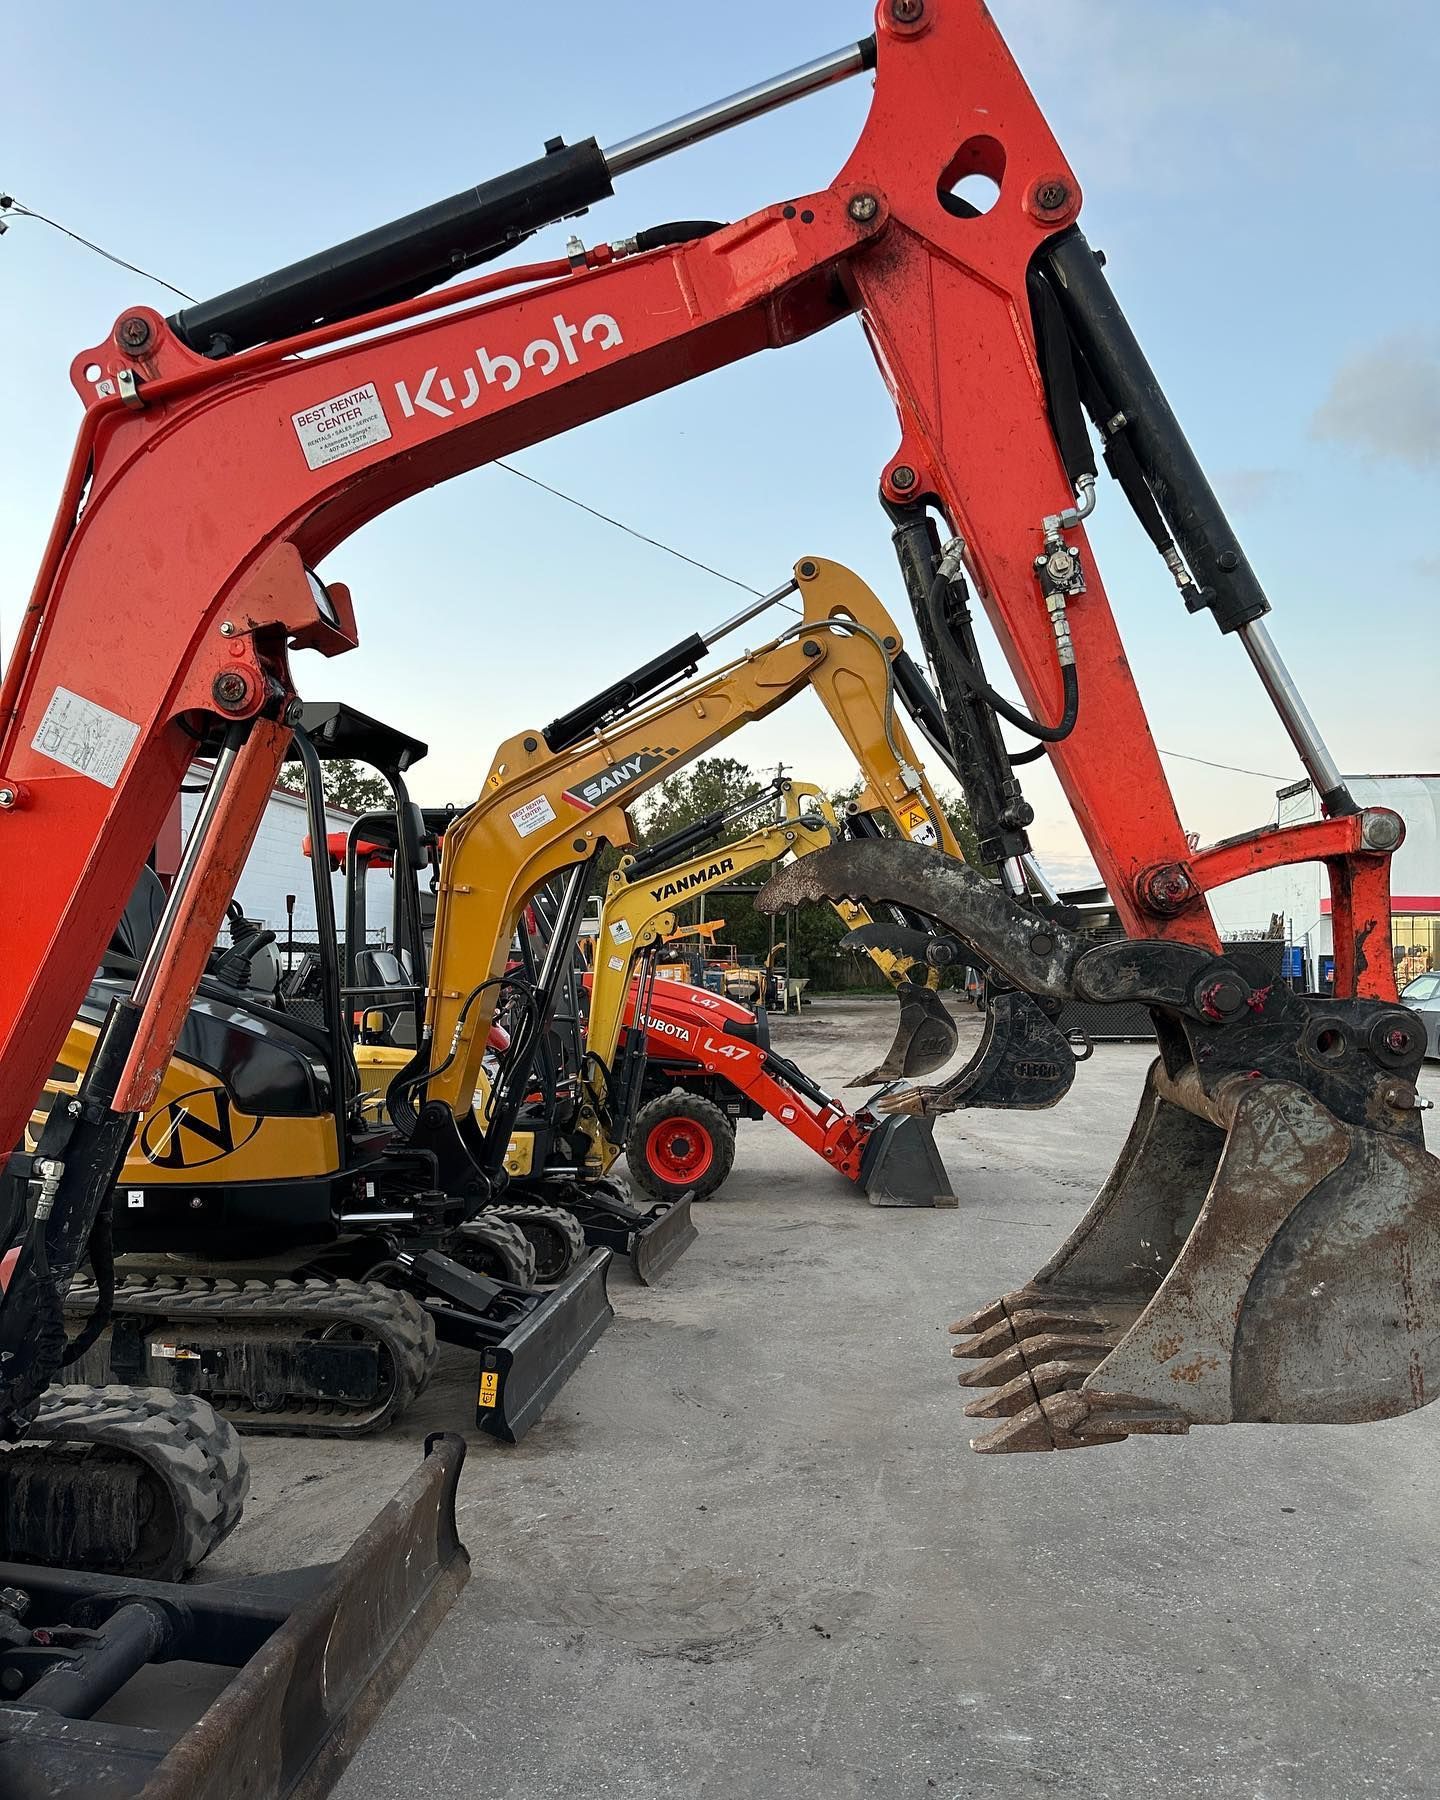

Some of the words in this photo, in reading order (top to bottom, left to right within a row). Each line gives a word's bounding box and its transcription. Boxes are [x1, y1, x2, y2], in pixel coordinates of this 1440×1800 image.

[394, 313, 624, 418] Kubota
[297, 407, 326, 427] BEST
[329, 389, 374, 414] RENTAL
[317, 407, 363, 433] CENTER
[307, 433, 332, 447] RENTALS
[334, 425, 353, 436] SALES
[355, 414, 378, 427] SERVICE
[583, 755, 642, 802] SANY
[511, 807, 526, 820] BEST
[525, 797, 545, 811] RENTAL
[521, 806, 542, 821] CENTER
[650, 857, 734, 903] YANMAR
[690, 994, 720, 1009] L47
[703, 1037, 751, 1061] L47
